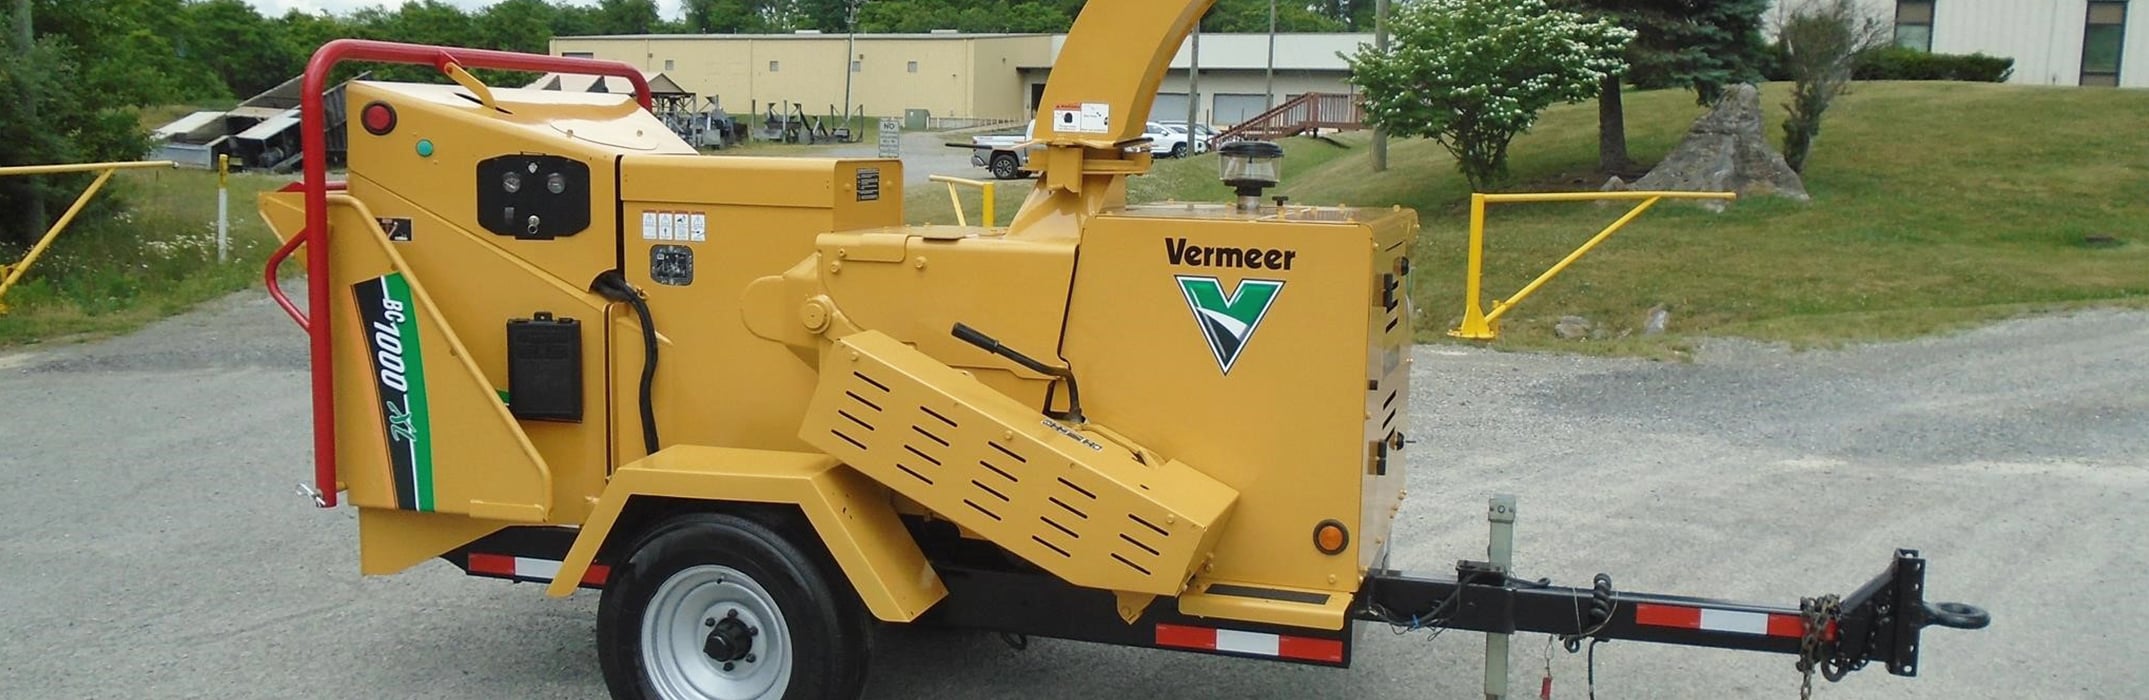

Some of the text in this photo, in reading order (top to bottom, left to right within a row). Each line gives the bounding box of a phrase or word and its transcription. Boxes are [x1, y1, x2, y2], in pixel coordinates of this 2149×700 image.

[883, 122, 896, 130] NO
[1164, 237, 1296, 271] Vermeer
[386, 400, 417, 442] XL
